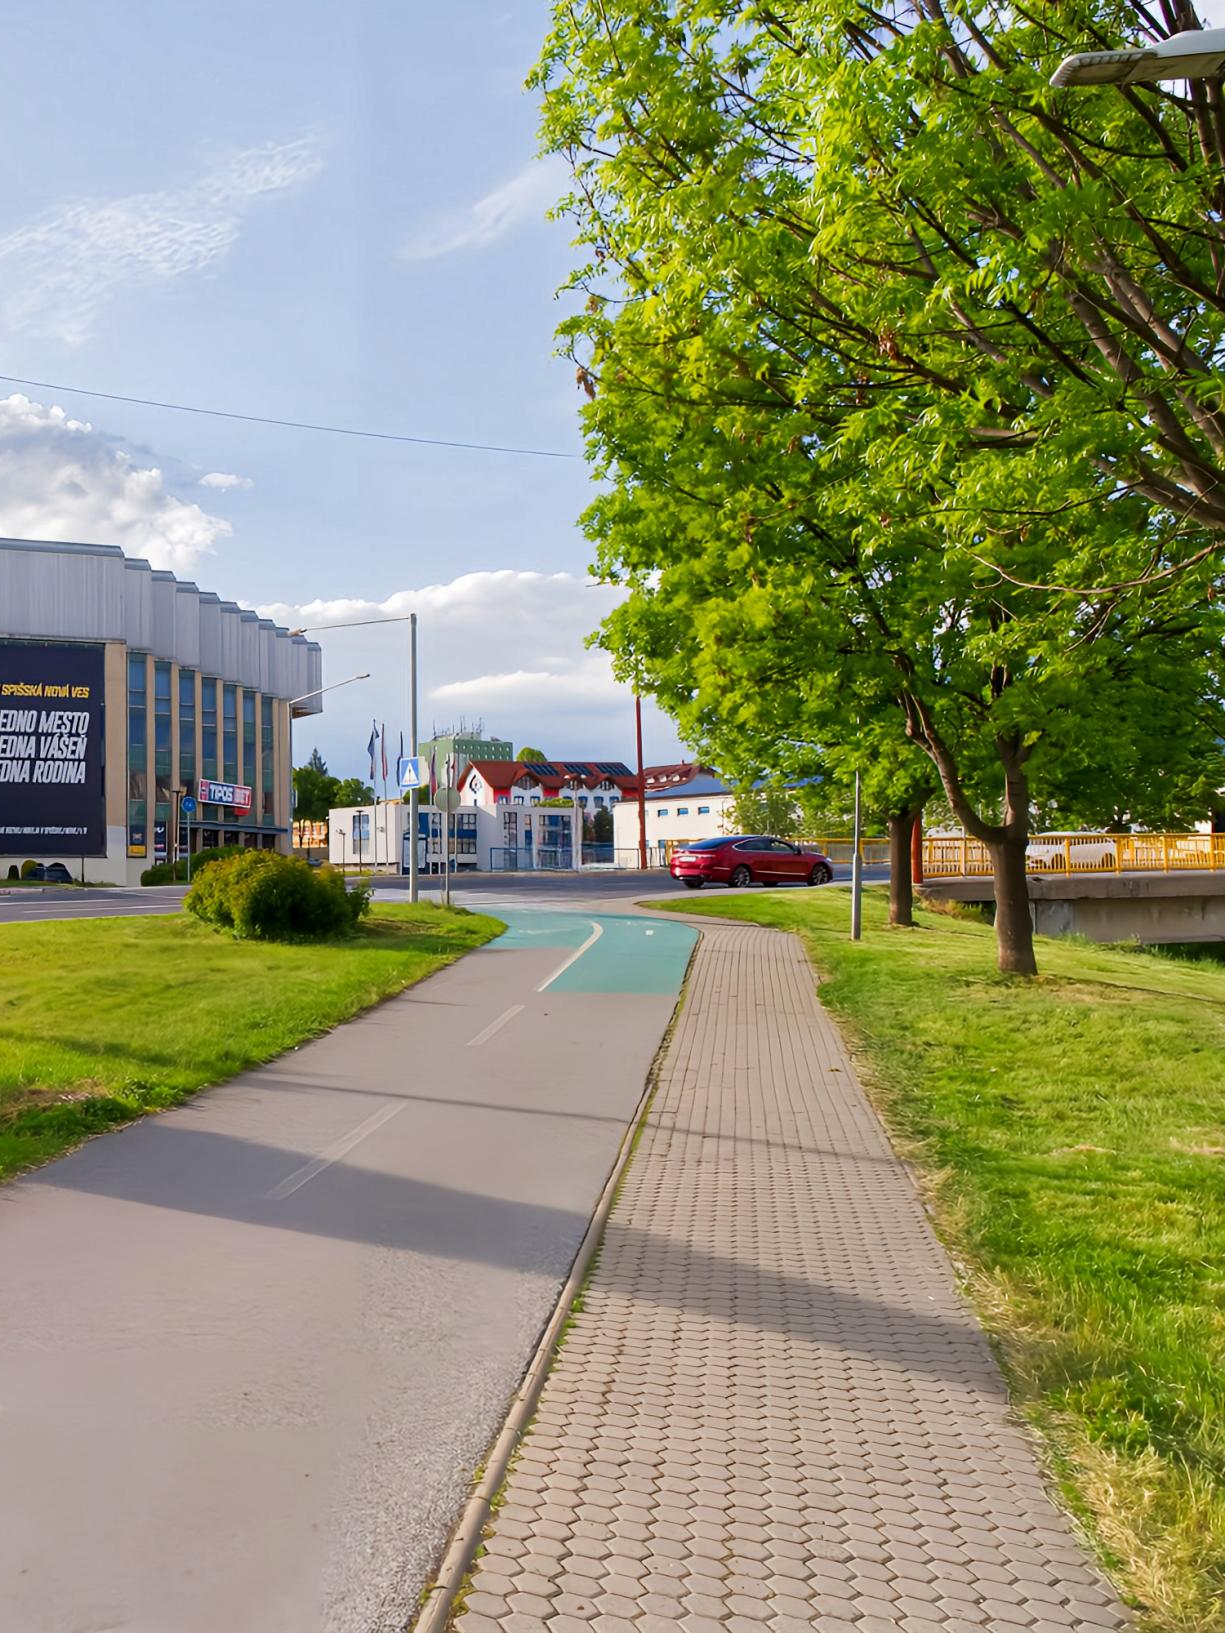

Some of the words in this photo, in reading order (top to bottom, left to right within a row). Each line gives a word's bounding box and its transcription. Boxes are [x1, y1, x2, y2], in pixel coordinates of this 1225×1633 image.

[71, 686, 90, 698] VES
[38, 710, 90, 735] MESTO
[39, 733, 88, 760] VÁŠEŇ
[32, 760, 87, 784] RODINA
